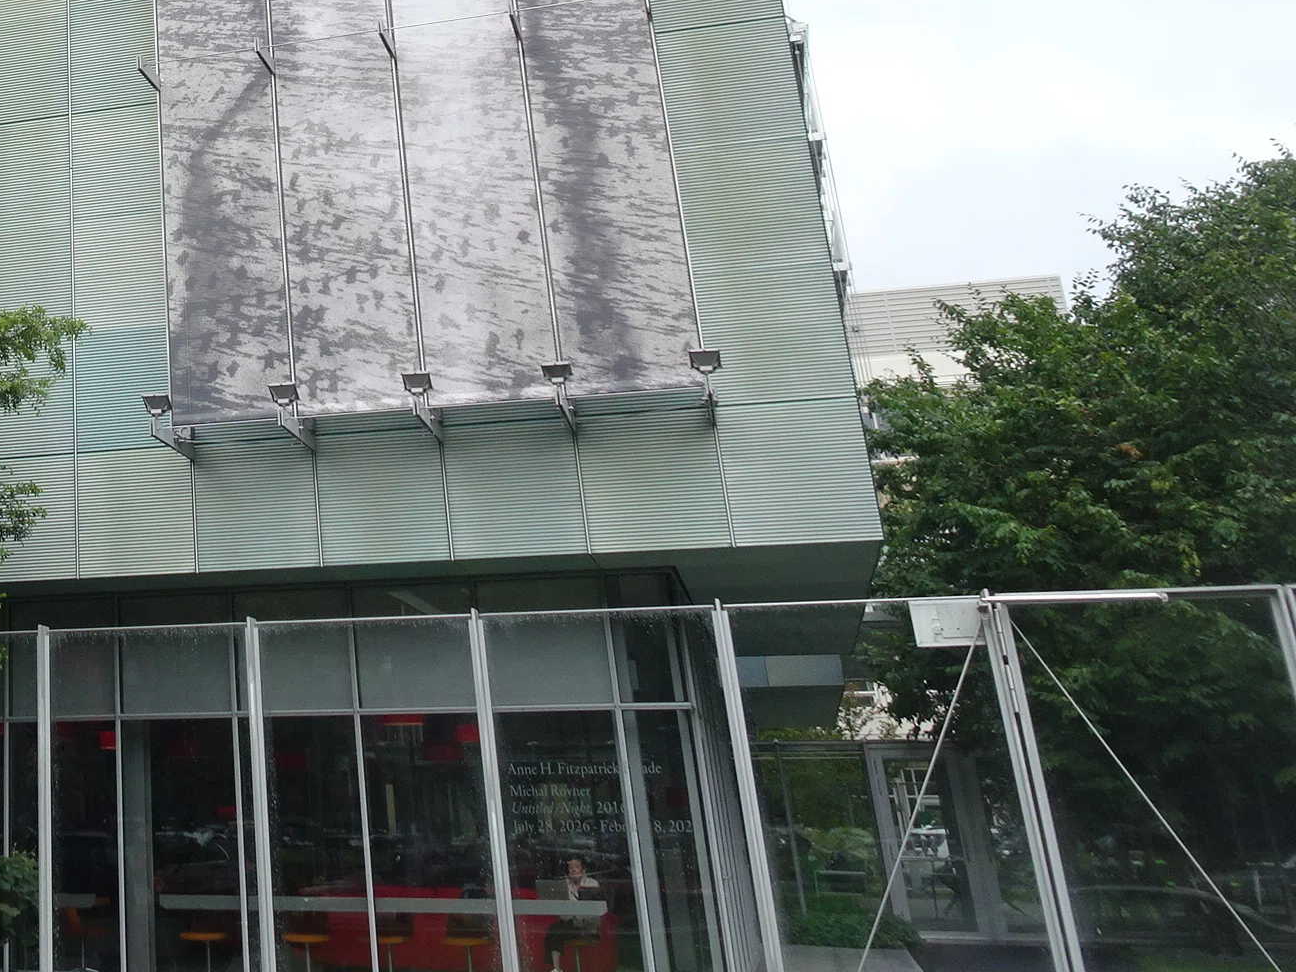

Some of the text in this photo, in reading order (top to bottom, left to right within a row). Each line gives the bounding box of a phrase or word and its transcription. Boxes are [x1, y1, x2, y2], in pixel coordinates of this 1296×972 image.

[508, 763, 537, 775] Anne
[540, 762, 555, 775] H.
[558, 762, 620, 777] Fitzpatrick
[510, 784, 591, 798] Michal Rovner
[513, 819, 534, 834] July
[560, 819, 590, 832] 2026
[669, 819, 693, 833] 202
